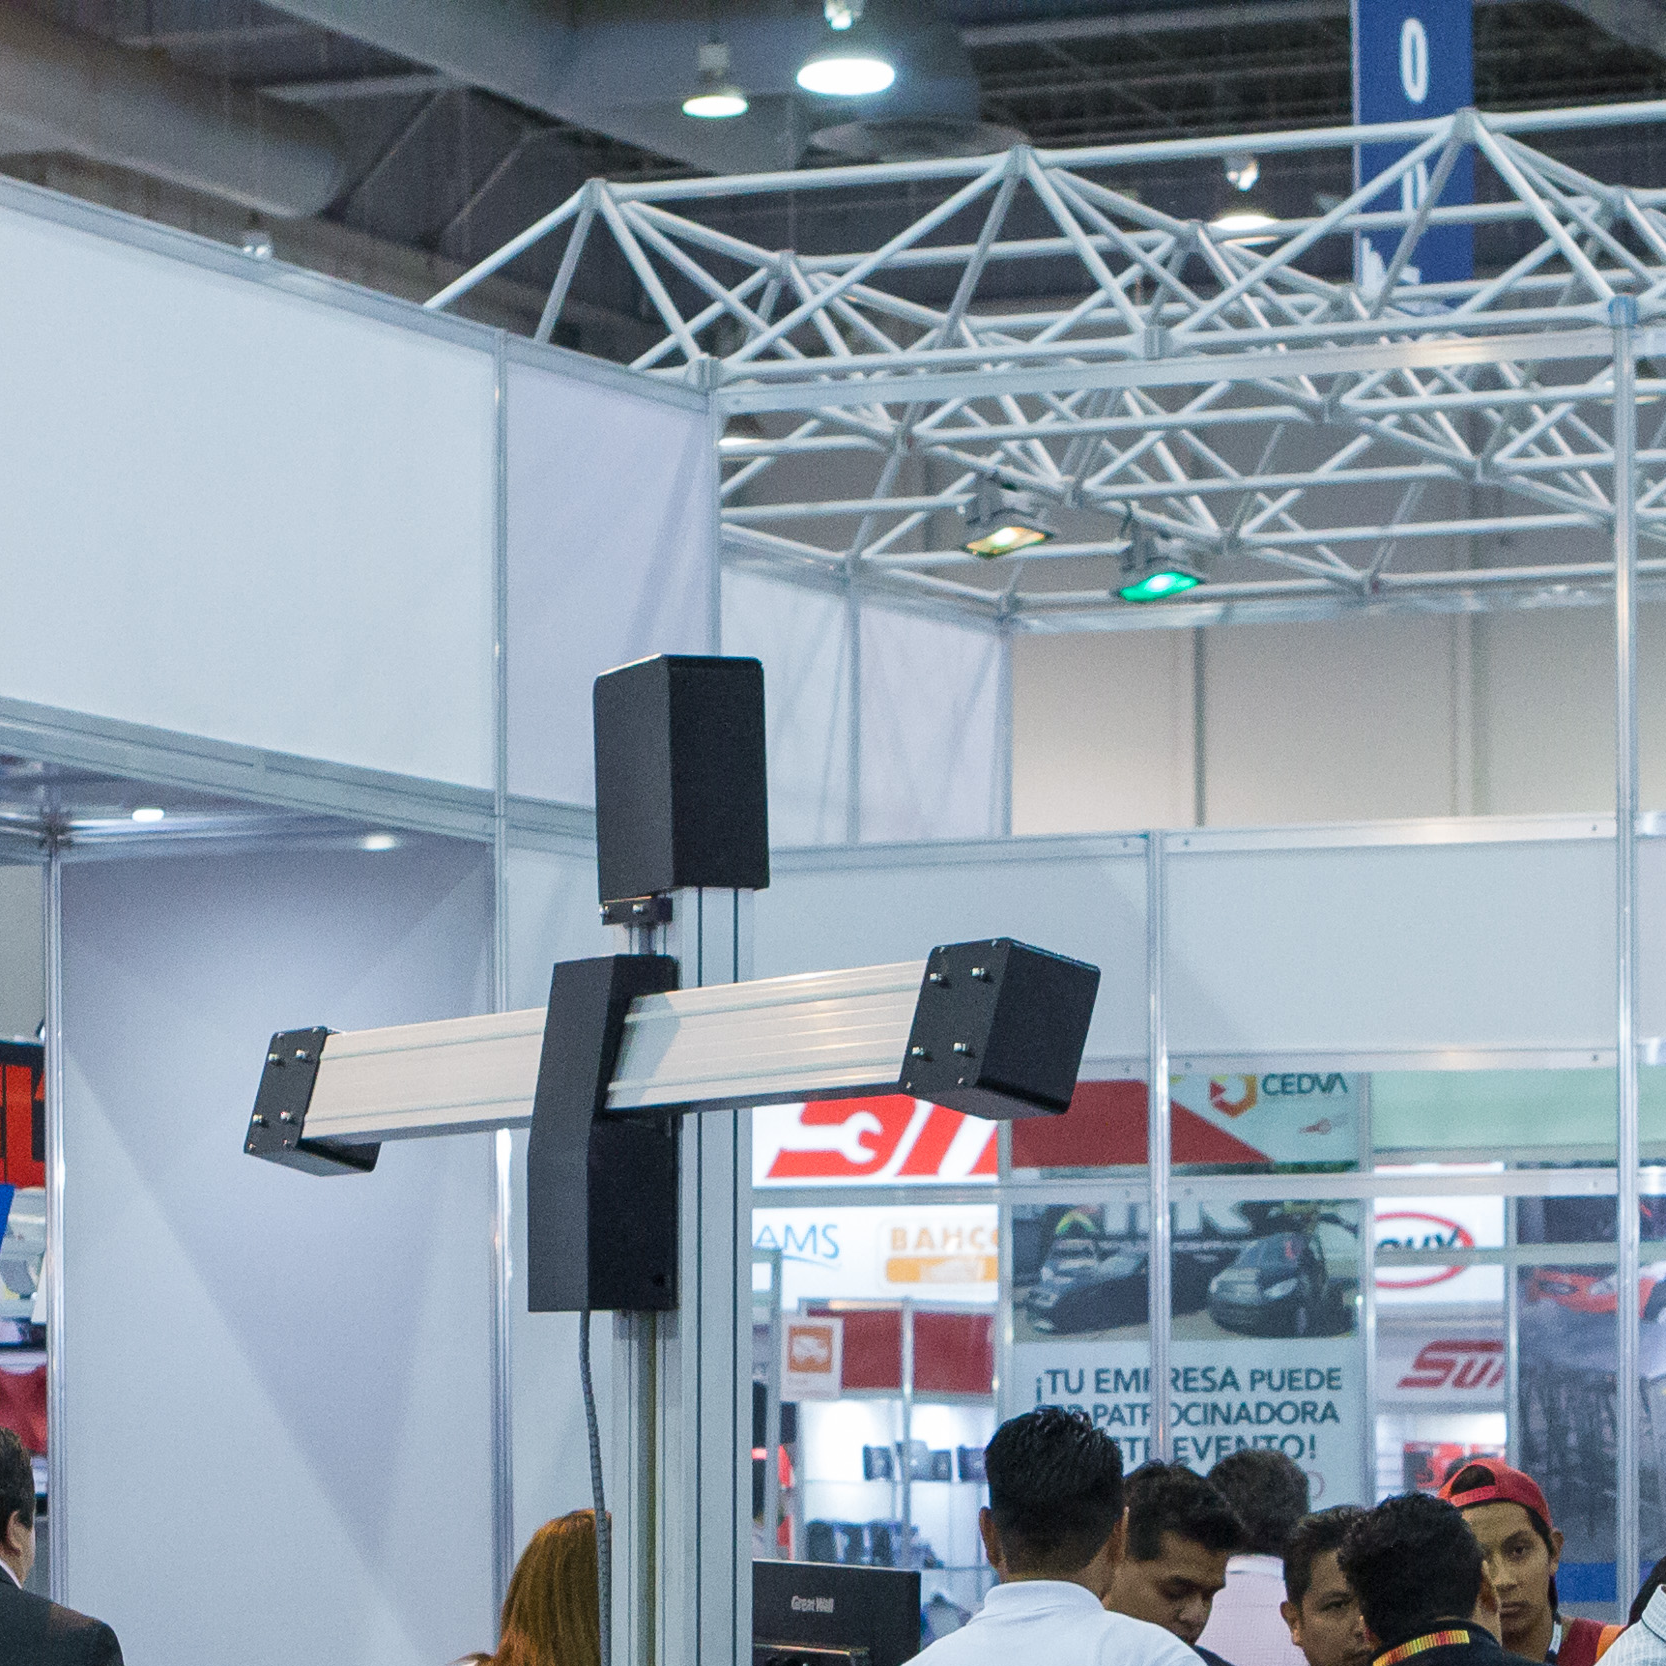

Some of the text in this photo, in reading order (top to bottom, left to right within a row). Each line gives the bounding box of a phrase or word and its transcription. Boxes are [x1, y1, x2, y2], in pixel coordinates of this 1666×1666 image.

[1262, 1073, 1348, 1095] CEDVA
[890, 1226, 998, 1251] BAHC
[1250, 1367, 1342, 1392] PUEDE
